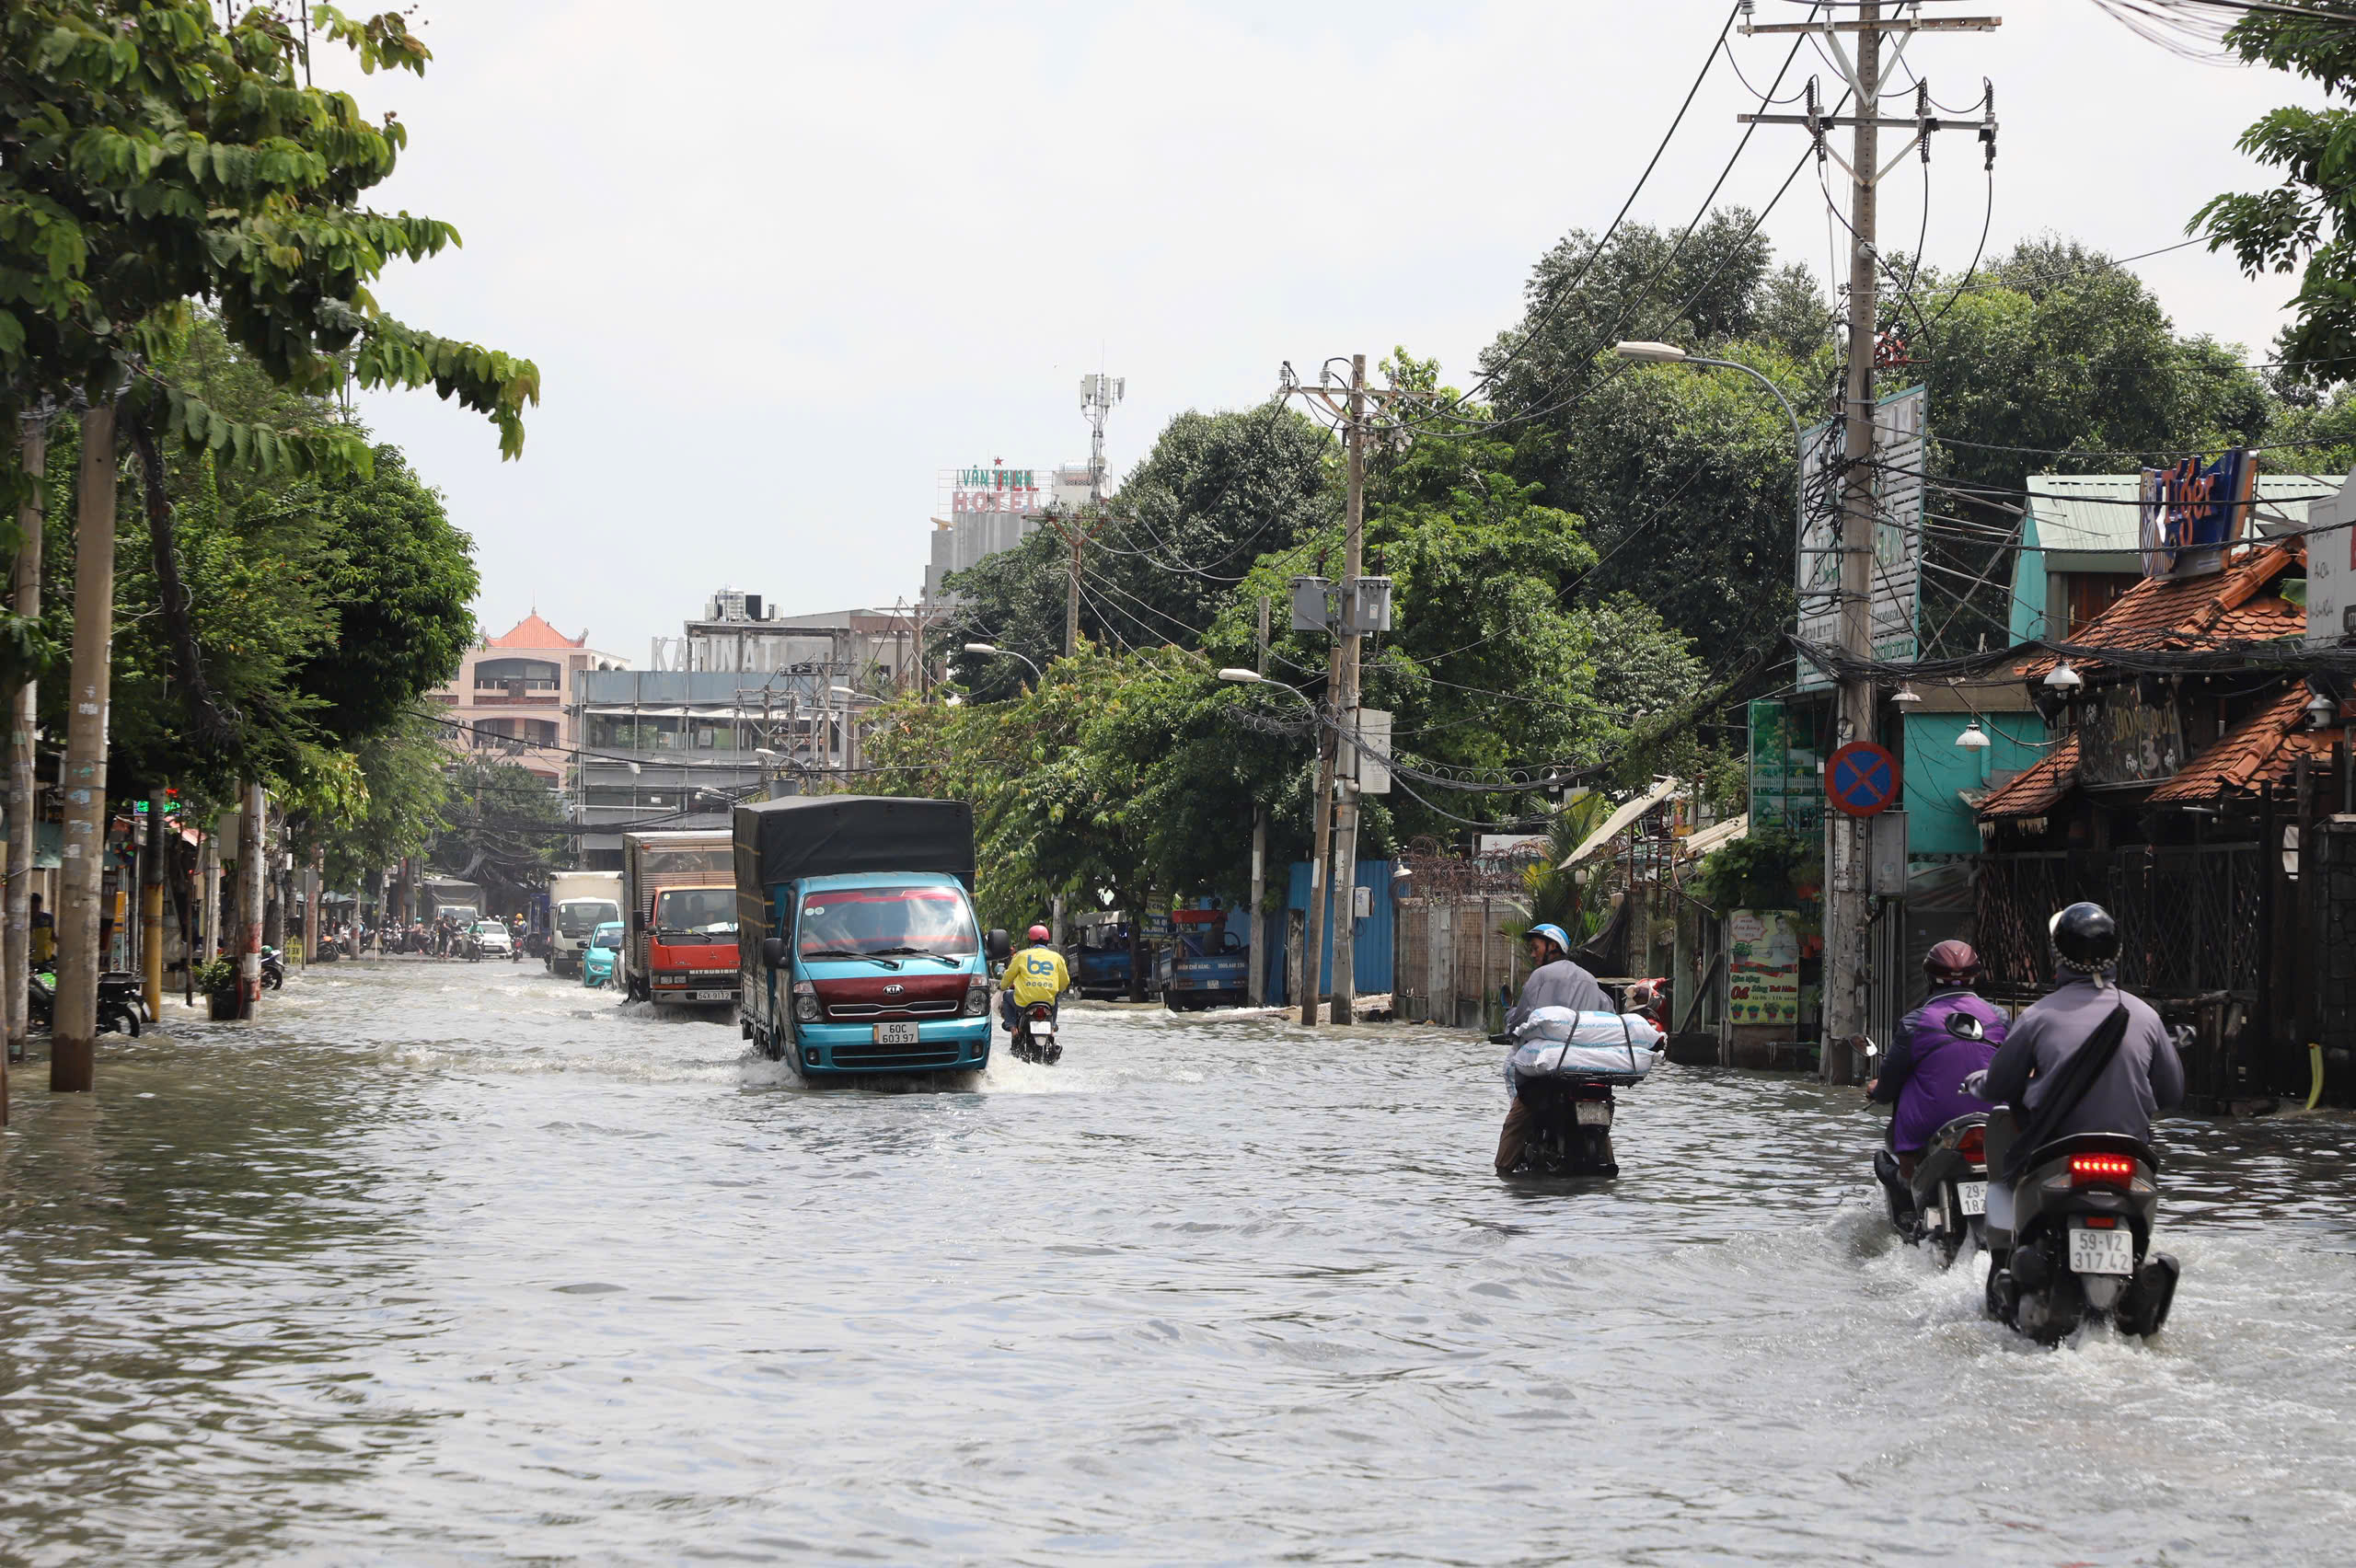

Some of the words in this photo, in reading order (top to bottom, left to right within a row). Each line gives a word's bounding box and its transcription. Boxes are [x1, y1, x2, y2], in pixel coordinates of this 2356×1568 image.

[963, 464, 988, 486] VÂN
[953, 491, 1040, 513] HOTEL
[2162, 457, 2215, 547] Tiger
[652, 636, 777, 673] KATINAT
[2141, 739, 2159, 771] 3
[1027, 954, 1054, 975] be
[883, 1034, 914, 1043] 603.97
[889, 1024, 907, 1033] 60C
[1965, 1184, 1987, 1198] 29-
[1964, 1199, 1986, 1213] 182
[2079, 1234, 2122, 1251] 59-V2
[2074, 1252, 2129, 1271] 317.42
